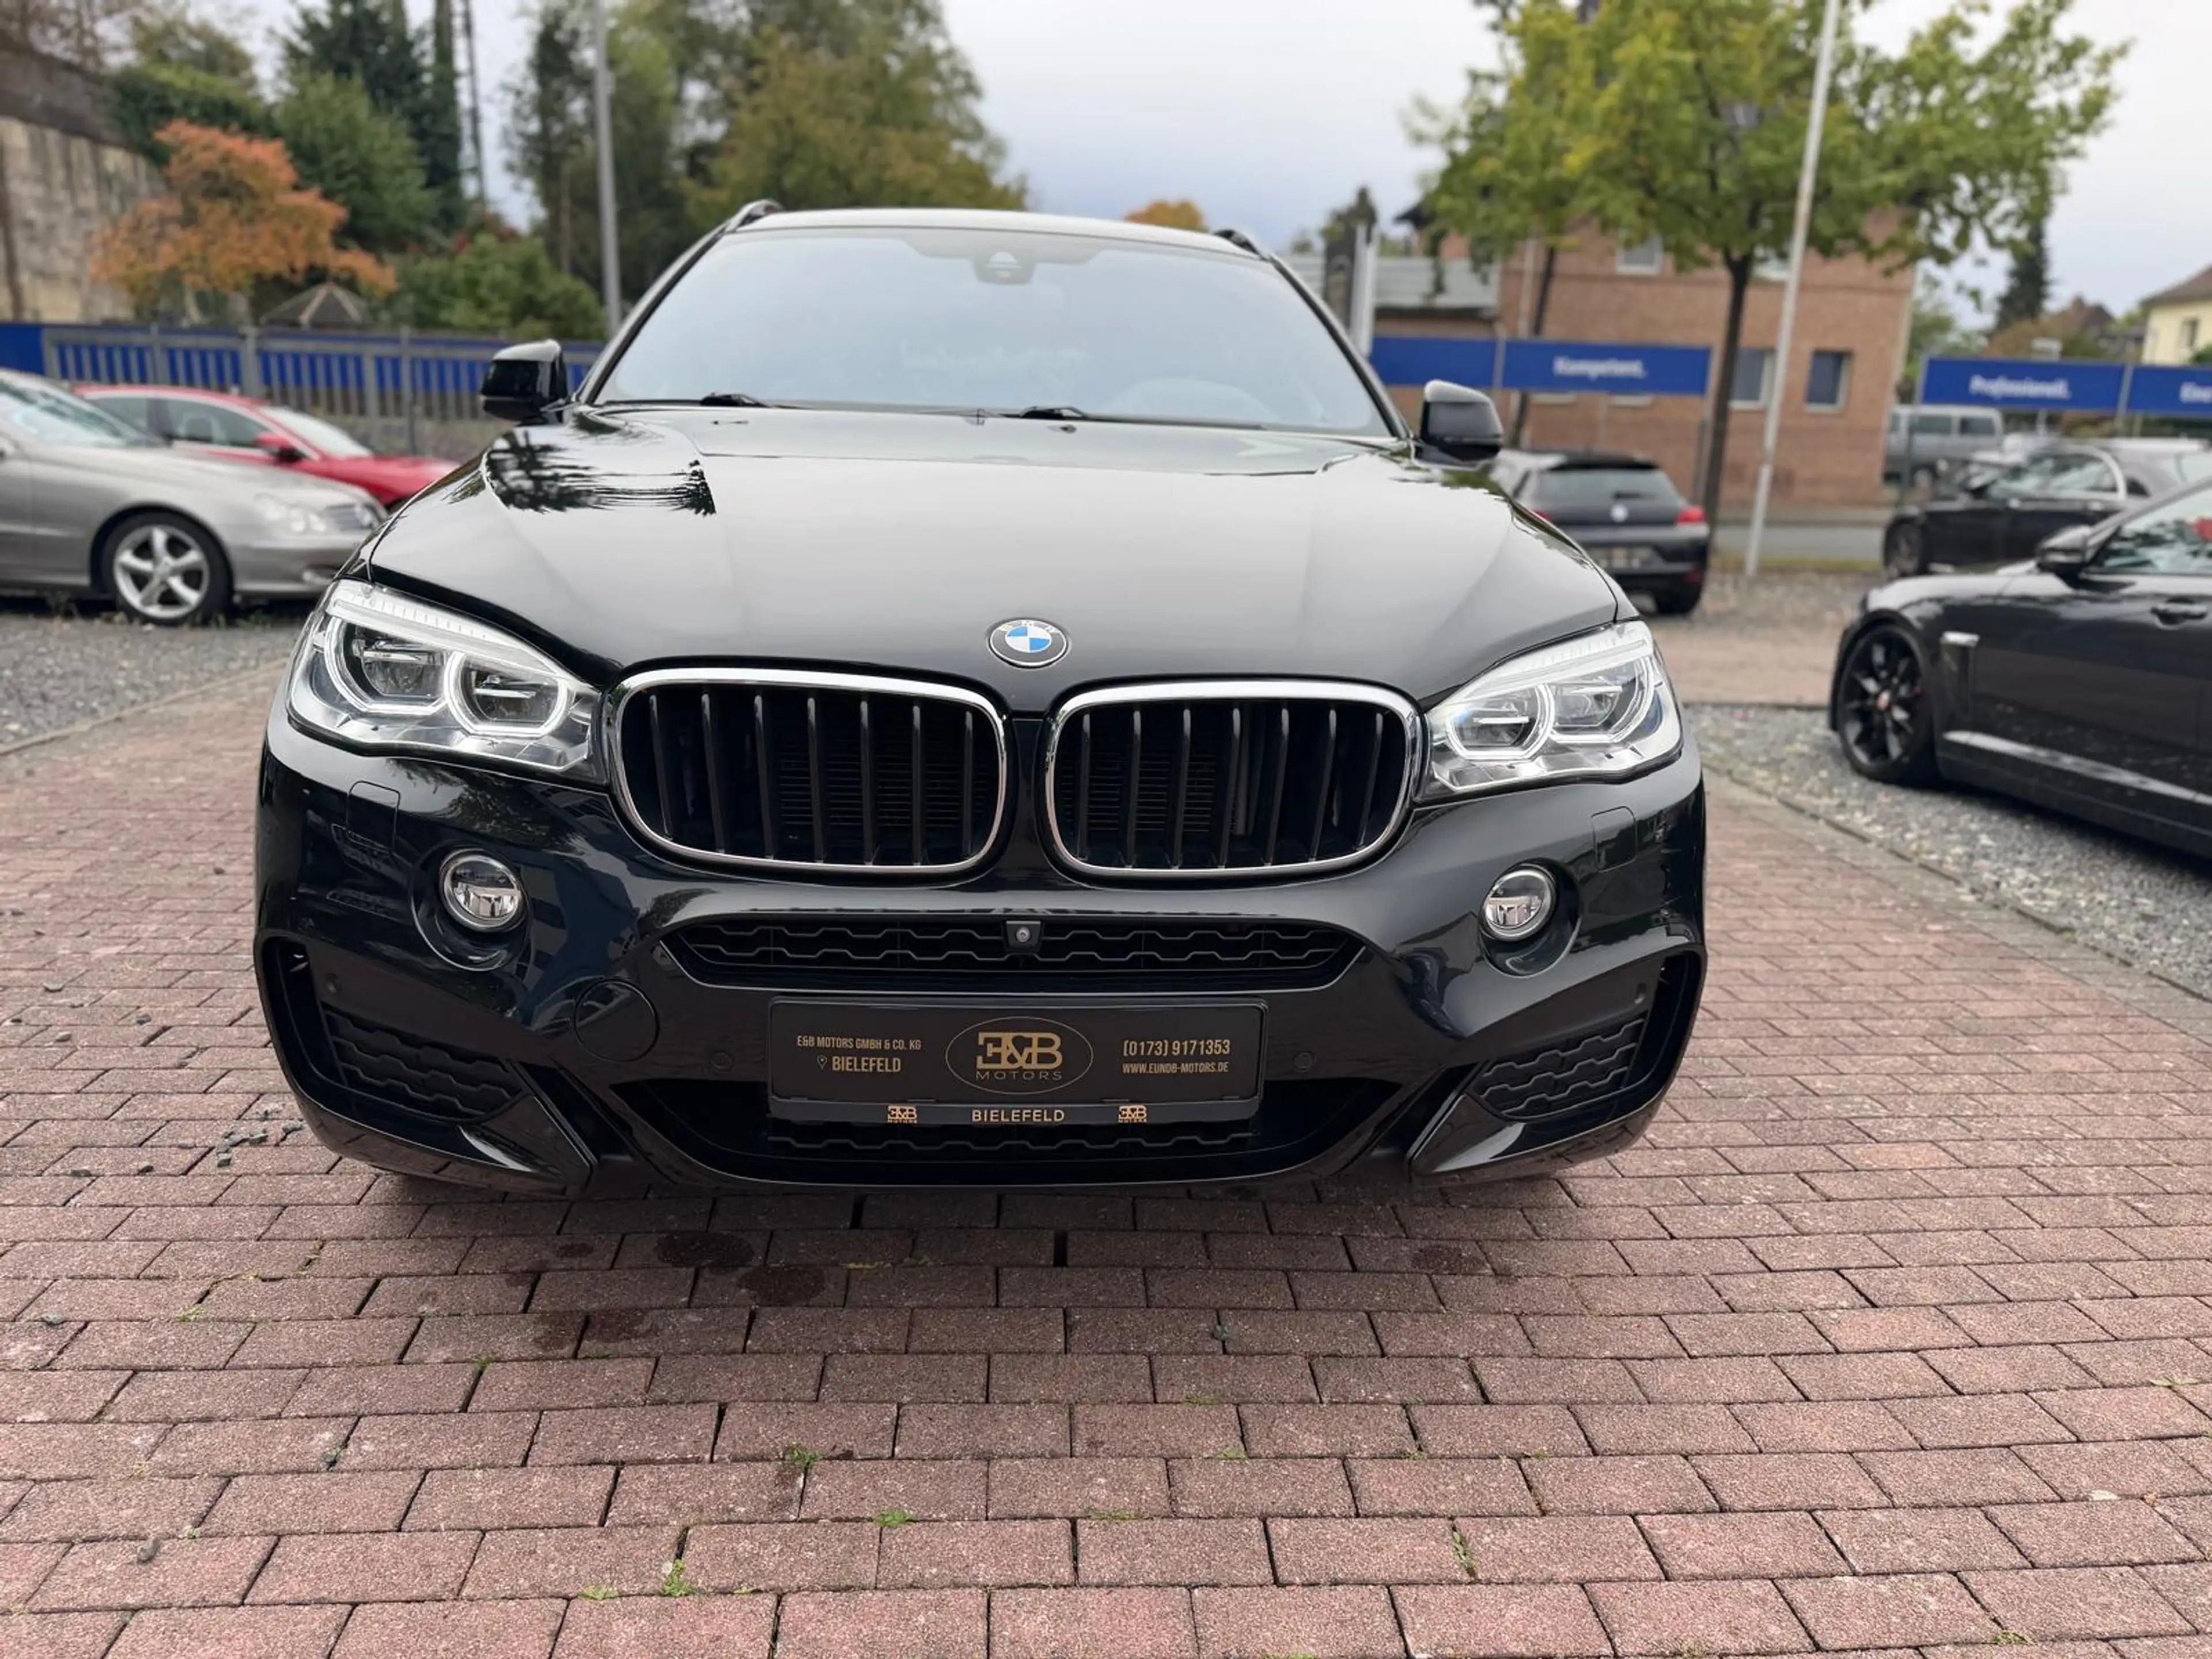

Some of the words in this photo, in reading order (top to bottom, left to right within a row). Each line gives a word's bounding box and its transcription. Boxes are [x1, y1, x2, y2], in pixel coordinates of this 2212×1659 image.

[817, 1036, 854, 1049] MOTORS
[855, 1039, 882, 1050] GMBH
[892, 1039, 907, 1050] CO.
[909, 1039, 922, 1050] KG
[1123, 1039, 1169, 1057] (0173)
[1172, 1039, 1230, 1056] 9171353
[832, 1056, 902, 1073] BIELEFELD
[976, 1070, 1063, 1081] MOTORS
[972, 1109, 1065, 1123] BIELEFELD
